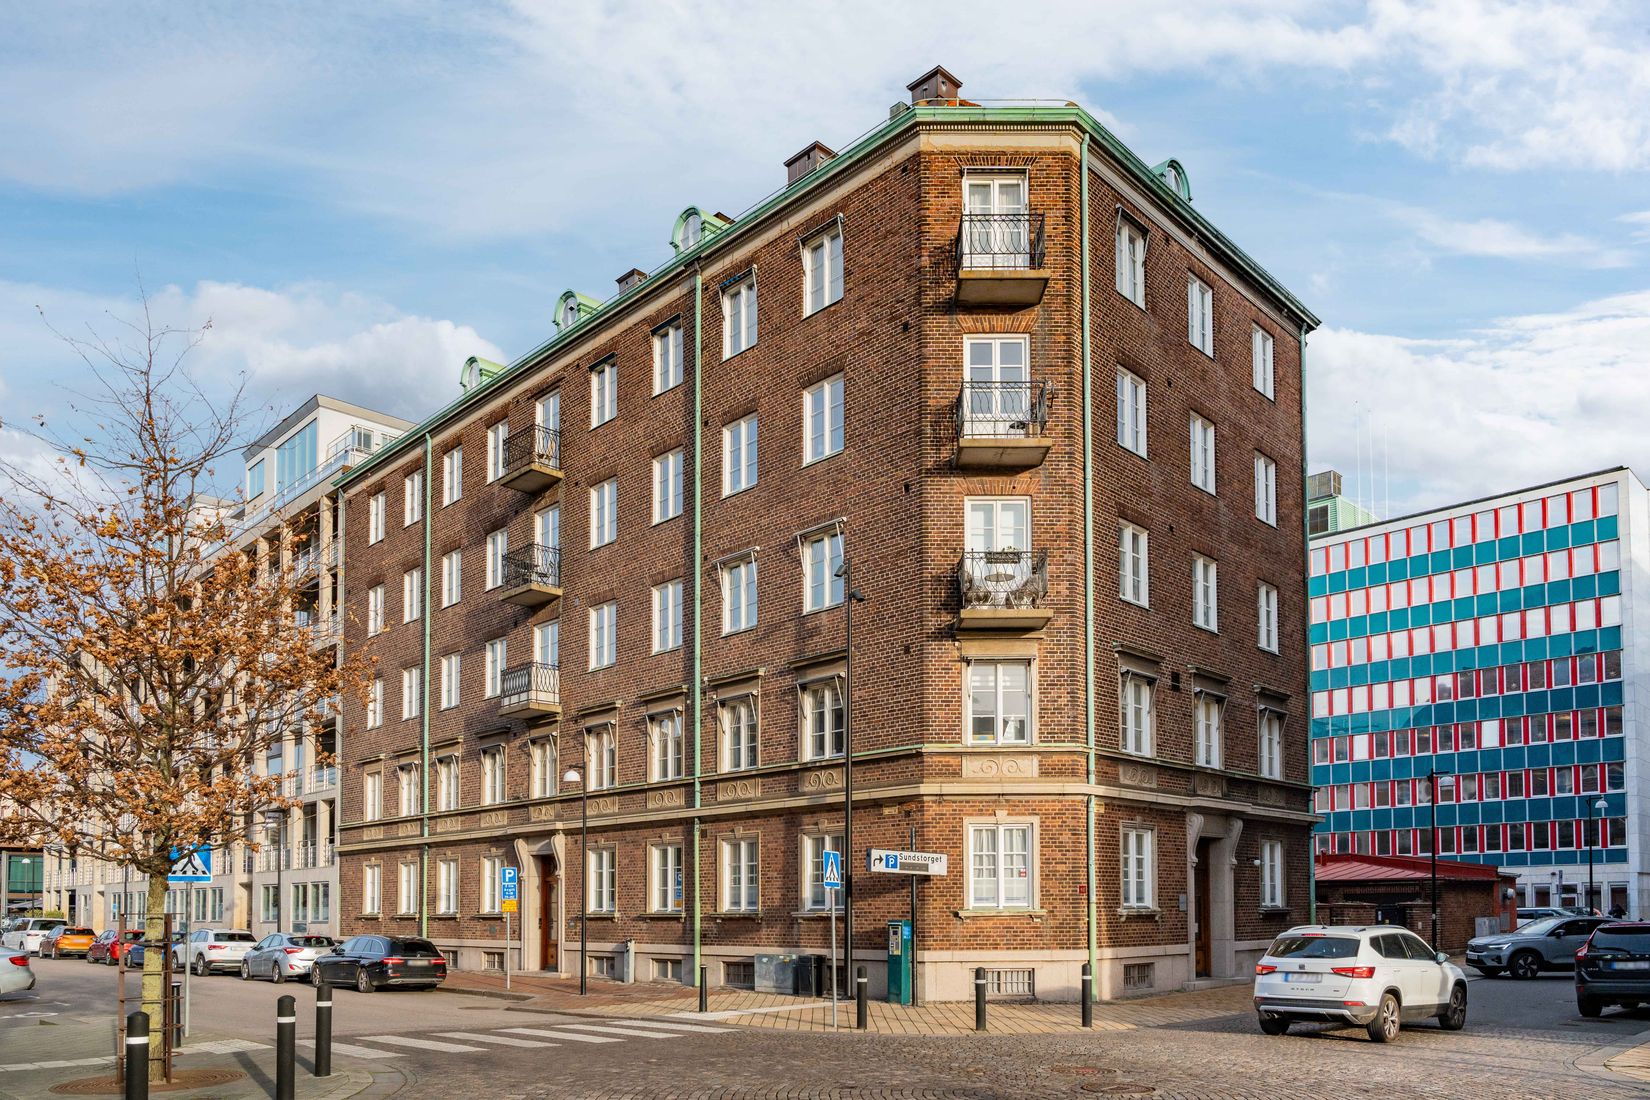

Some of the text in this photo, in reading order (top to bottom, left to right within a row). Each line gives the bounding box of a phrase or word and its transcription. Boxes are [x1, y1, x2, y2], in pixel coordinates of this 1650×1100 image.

[889, 853, 942, 868] P Sundstorget
[505, 870, 514, 882] P
